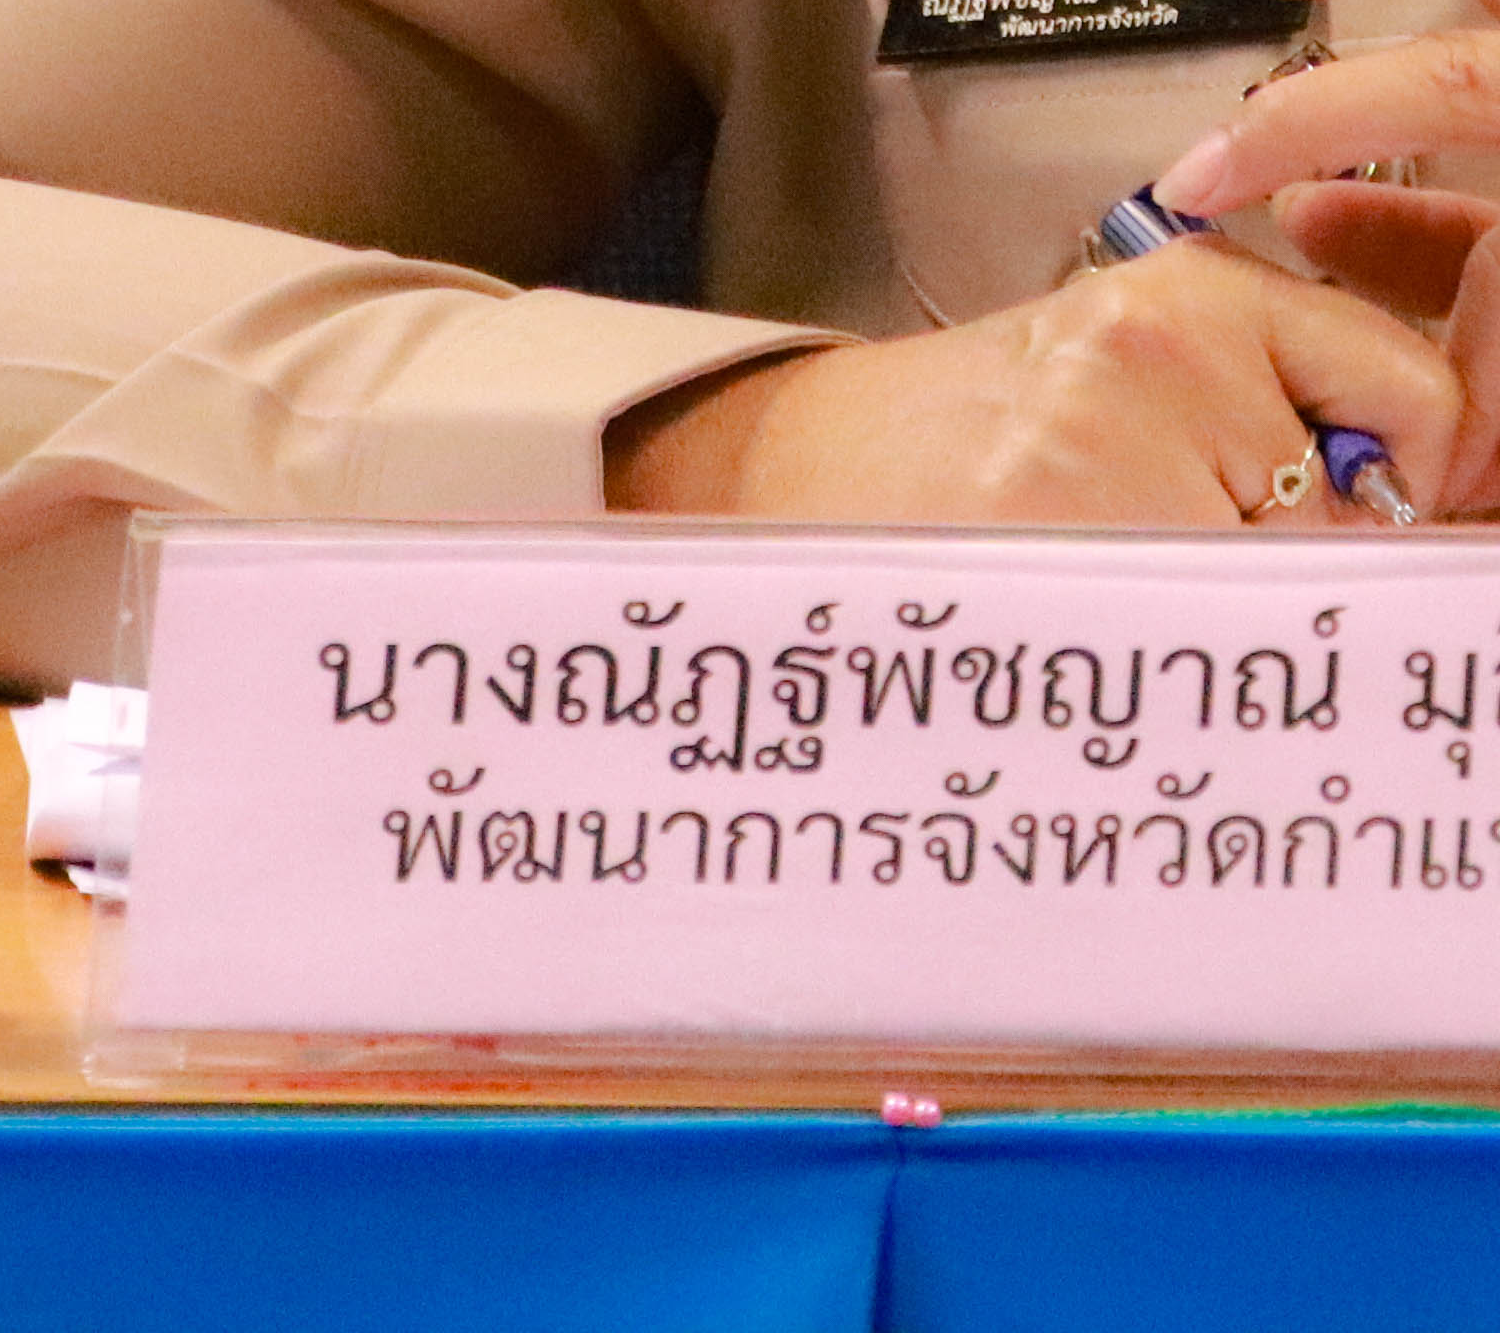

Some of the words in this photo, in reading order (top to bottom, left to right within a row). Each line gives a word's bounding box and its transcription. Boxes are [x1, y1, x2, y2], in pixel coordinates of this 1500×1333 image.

[1000, 5, 1179, 39] พัฒนาการจังหวัด
[318, 601, 1347, 771] นางณัฏฐ์พัชญาณ์
